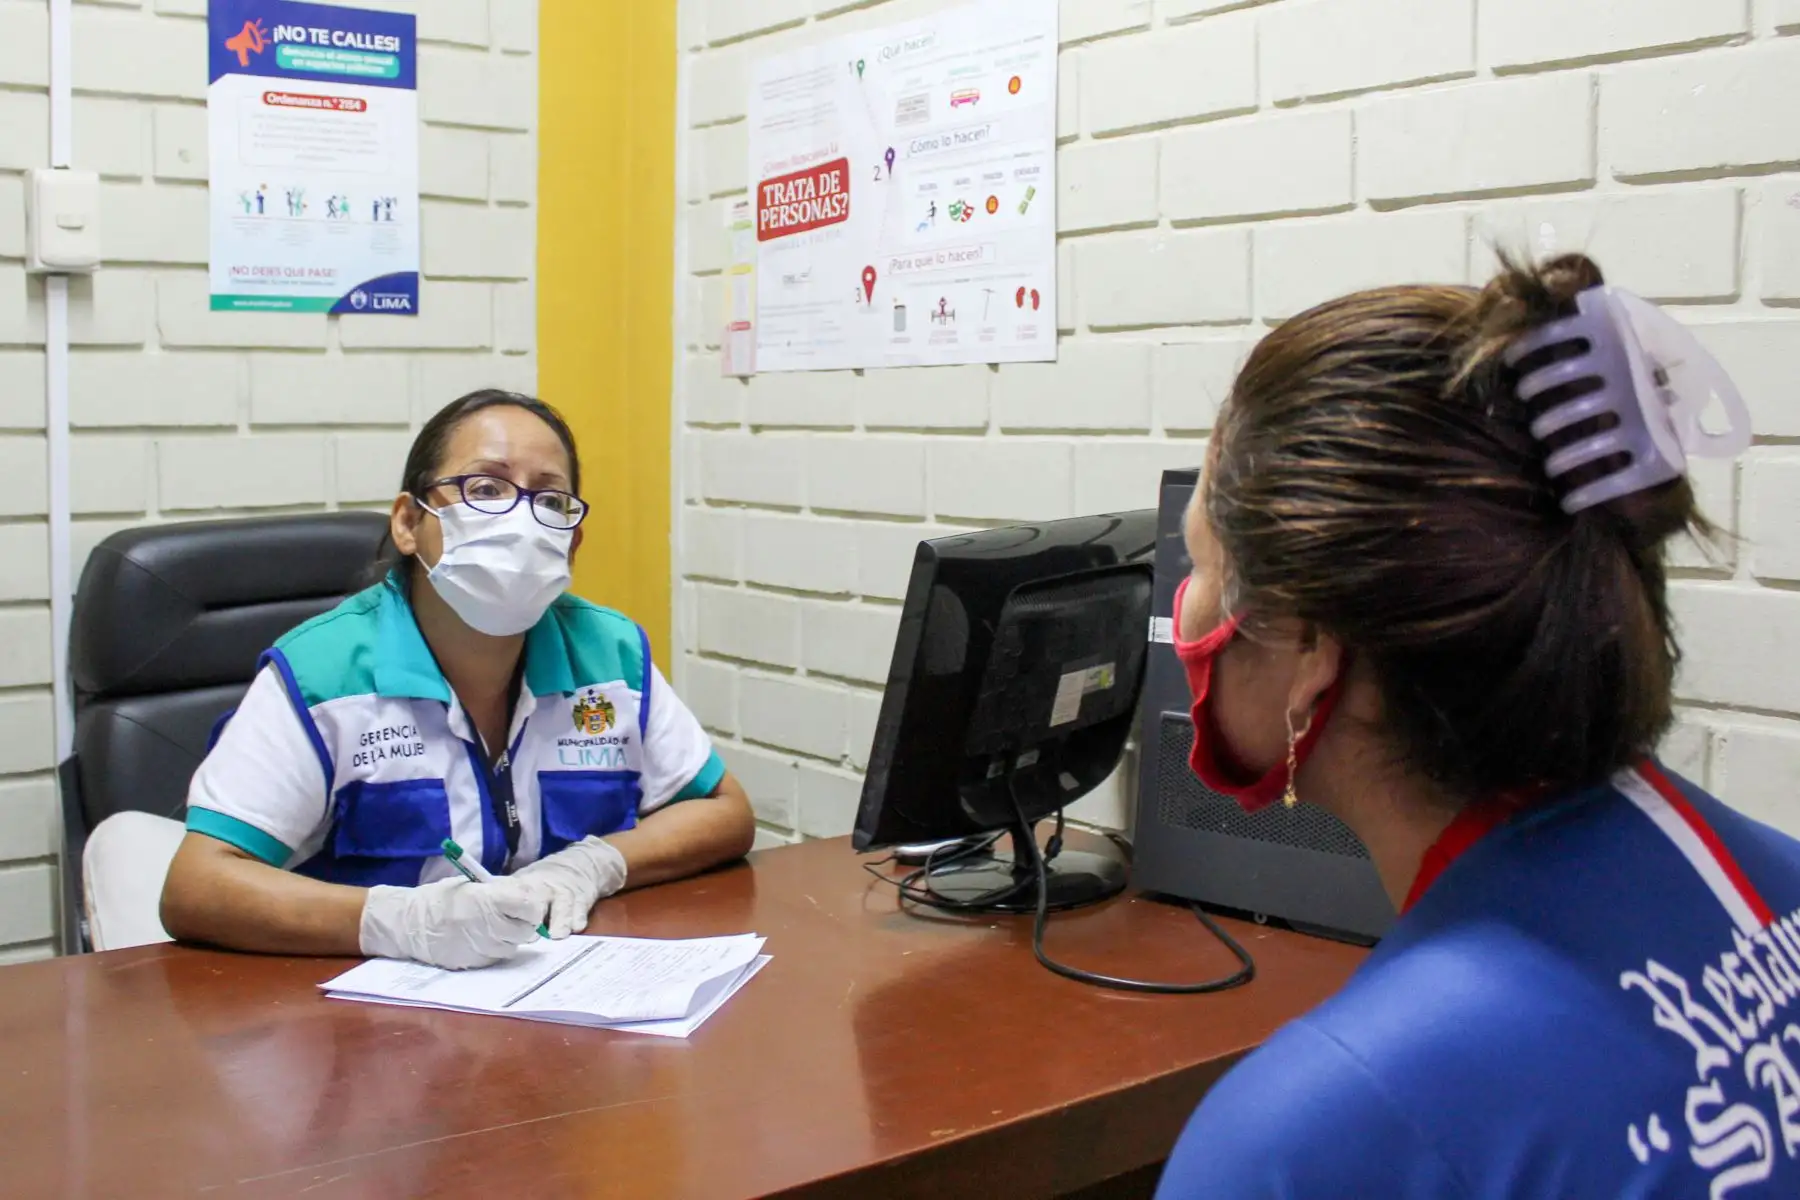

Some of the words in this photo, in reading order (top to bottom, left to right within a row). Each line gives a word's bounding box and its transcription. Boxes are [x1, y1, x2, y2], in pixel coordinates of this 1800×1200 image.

[273, 24, 306, 43] ¡NO
[308, 28, 330, 45] TE
[331, 30, 400, 52] CALLES!
[941, 134, 951, 147] lo
[954, 125, 991, 144] hacen?
[873, 165, 881, 182] 2
[763, 176, 816, 206] TRATA
[819, 170, 841, 196] DE
[760, 192, 848, 231] PERSONAS?
[949, 246, 983, 262] hacen?
[284, 267, 306, 277] QUE
[373, 298, 411, 309] LIMA
[360, 725, 417, 746] GERENCIA
[353, 752, 369, 767] DE
[370, 747, 386, 763] LA
[558, 748, 627, 767] LIMA
